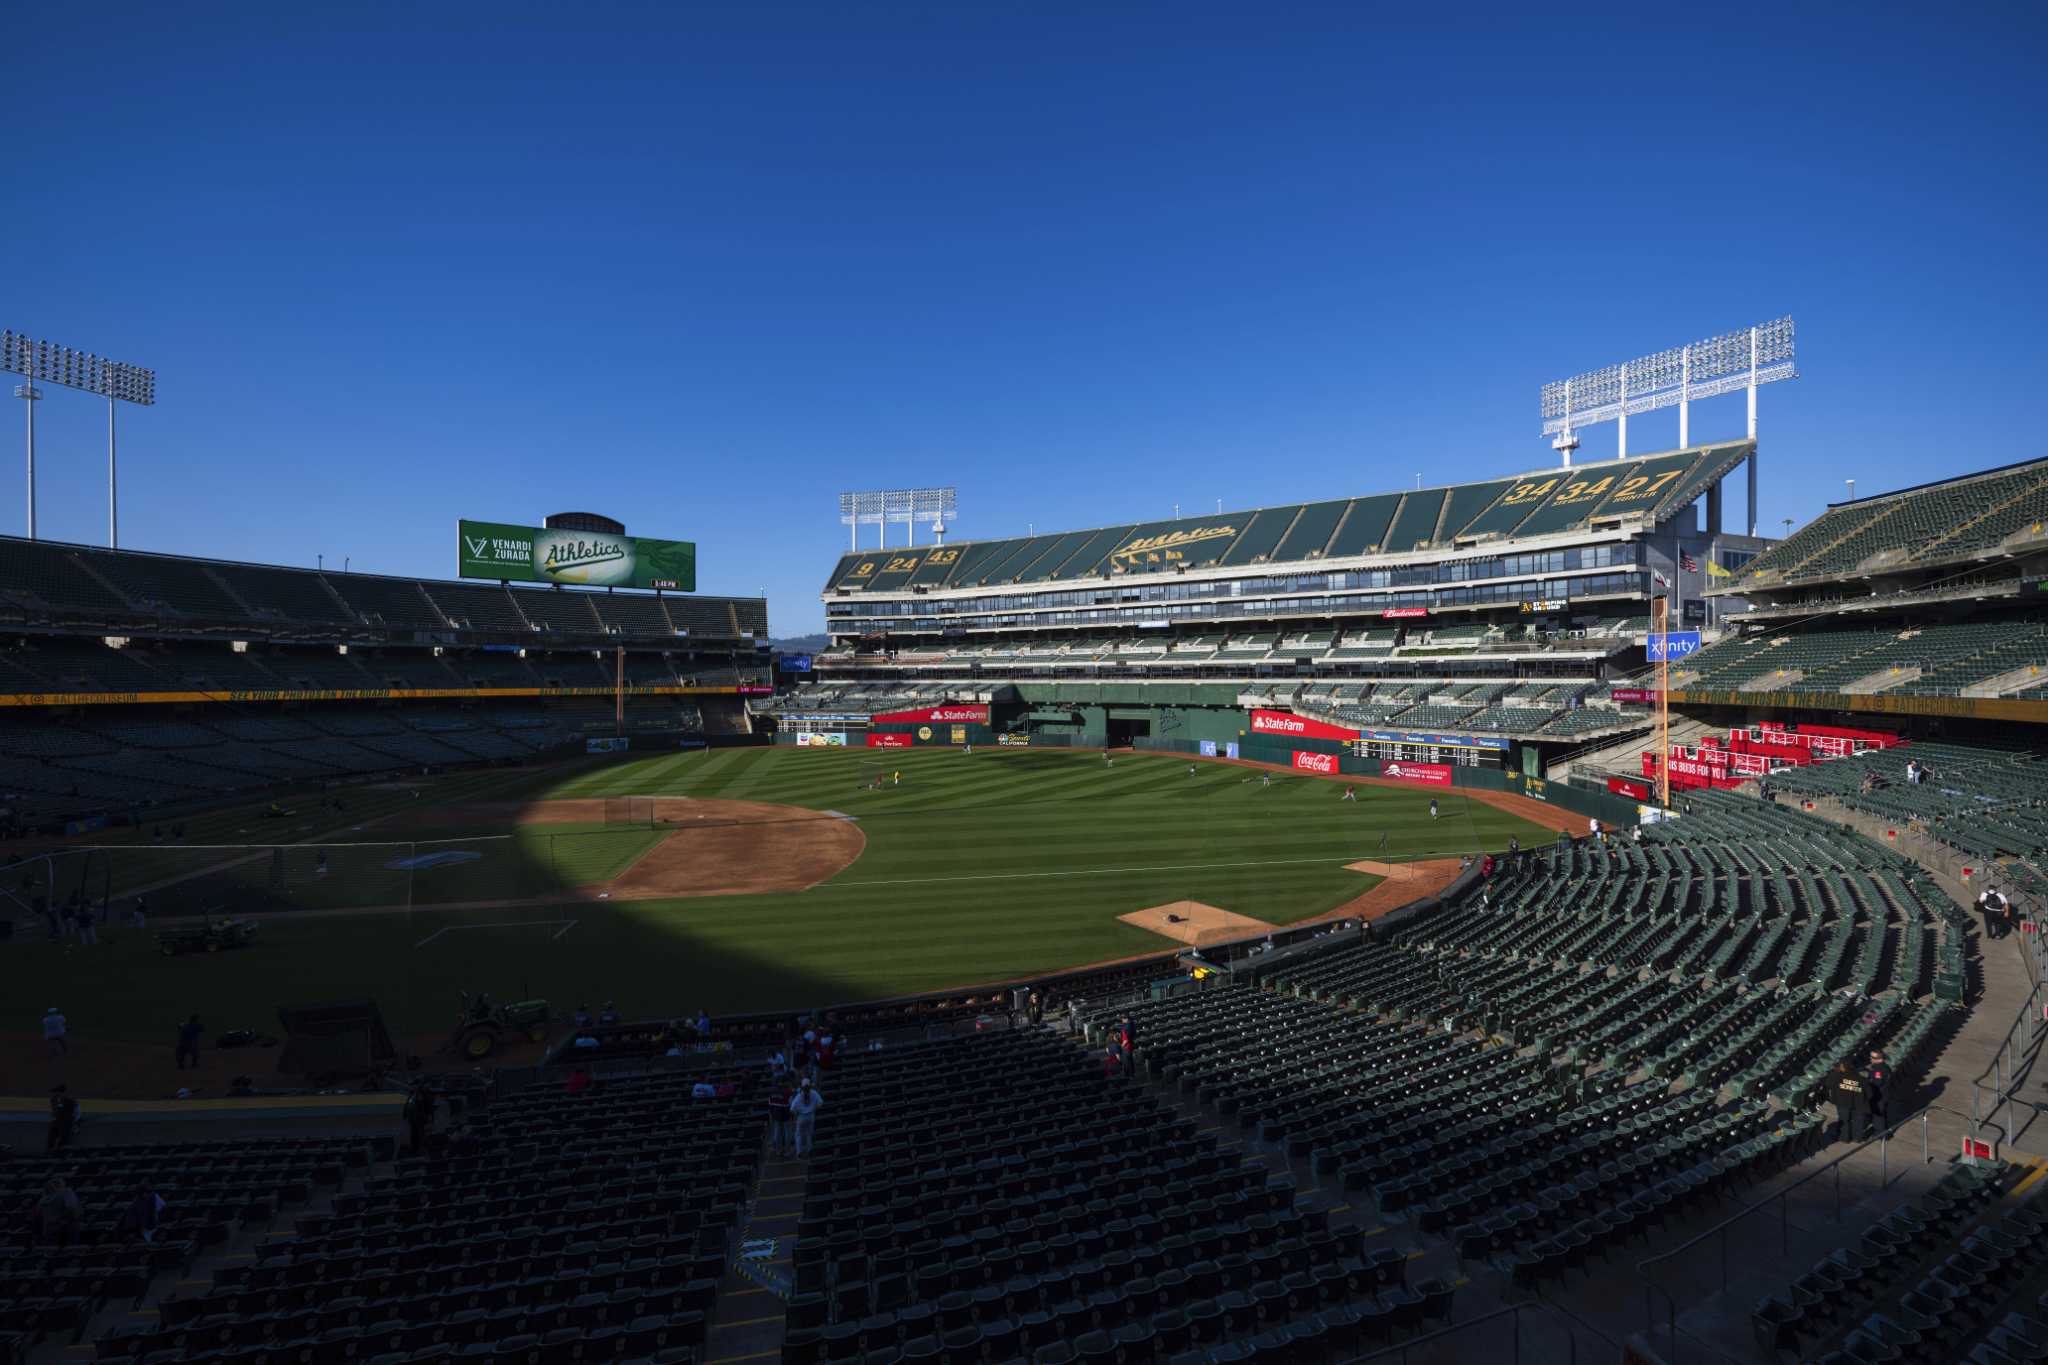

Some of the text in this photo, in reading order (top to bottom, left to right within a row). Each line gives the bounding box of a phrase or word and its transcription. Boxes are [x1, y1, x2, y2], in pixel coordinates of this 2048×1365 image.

[1505, 479, 1558, 501] 34
[1557, 476, 1615, 501] 34
[1616, 470, 1682, 497] 27
[492, 538, 531, 552] VENARDI
[494, 549, 531, 561] ZURADA
[544, 540, 624, 570] Athletics
[929, 550, 959, 564] 43
[857, 562, 875, 576] 9
[889, 557, 918, 571] 24
[1264, 717, 1305, 731] State Farm
